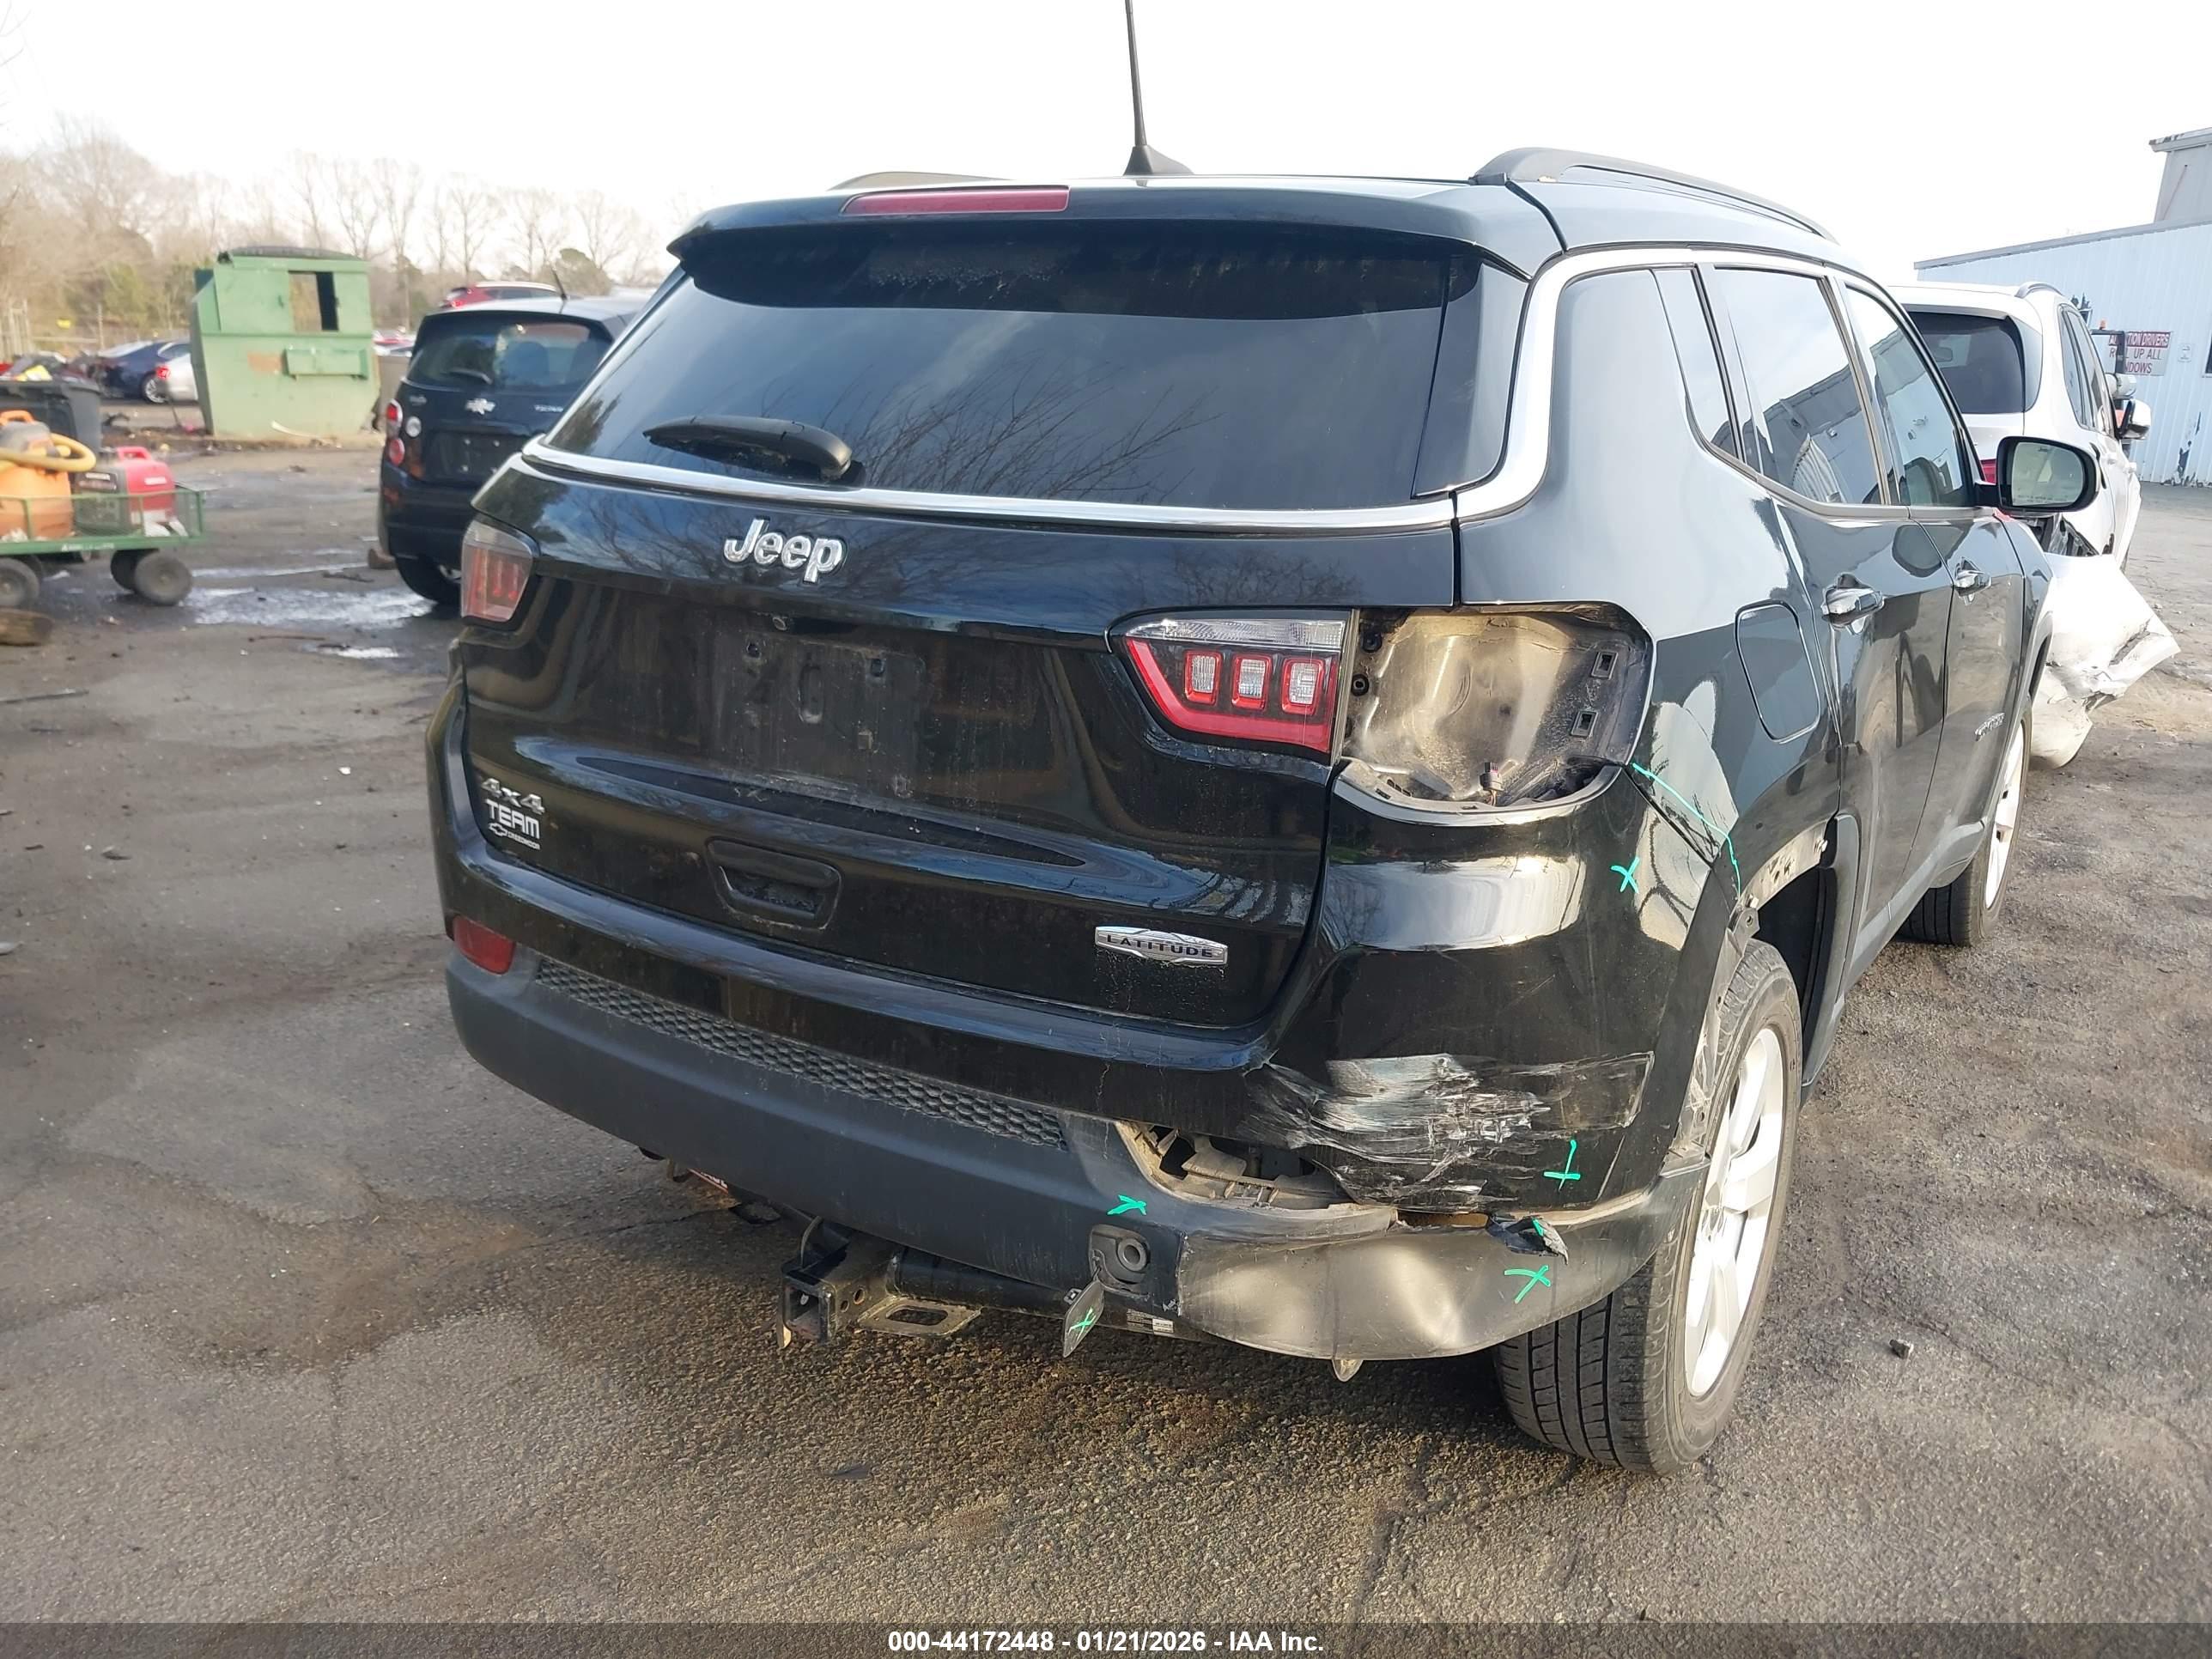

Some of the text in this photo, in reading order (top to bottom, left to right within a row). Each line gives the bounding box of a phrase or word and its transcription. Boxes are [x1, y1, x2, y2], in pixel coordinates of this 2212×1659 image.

[2109, 333, 2169, 347] ATION DRIVERS
[2109, 347, 2162, 360] RL UP ALL
[2124, 362, 2153, 374] NDOWS
[724, 517, 845, 583] Jeep
[484, 799, 540, 839] TEAM
[1107, 934, 1213, 957] LATITUDE
